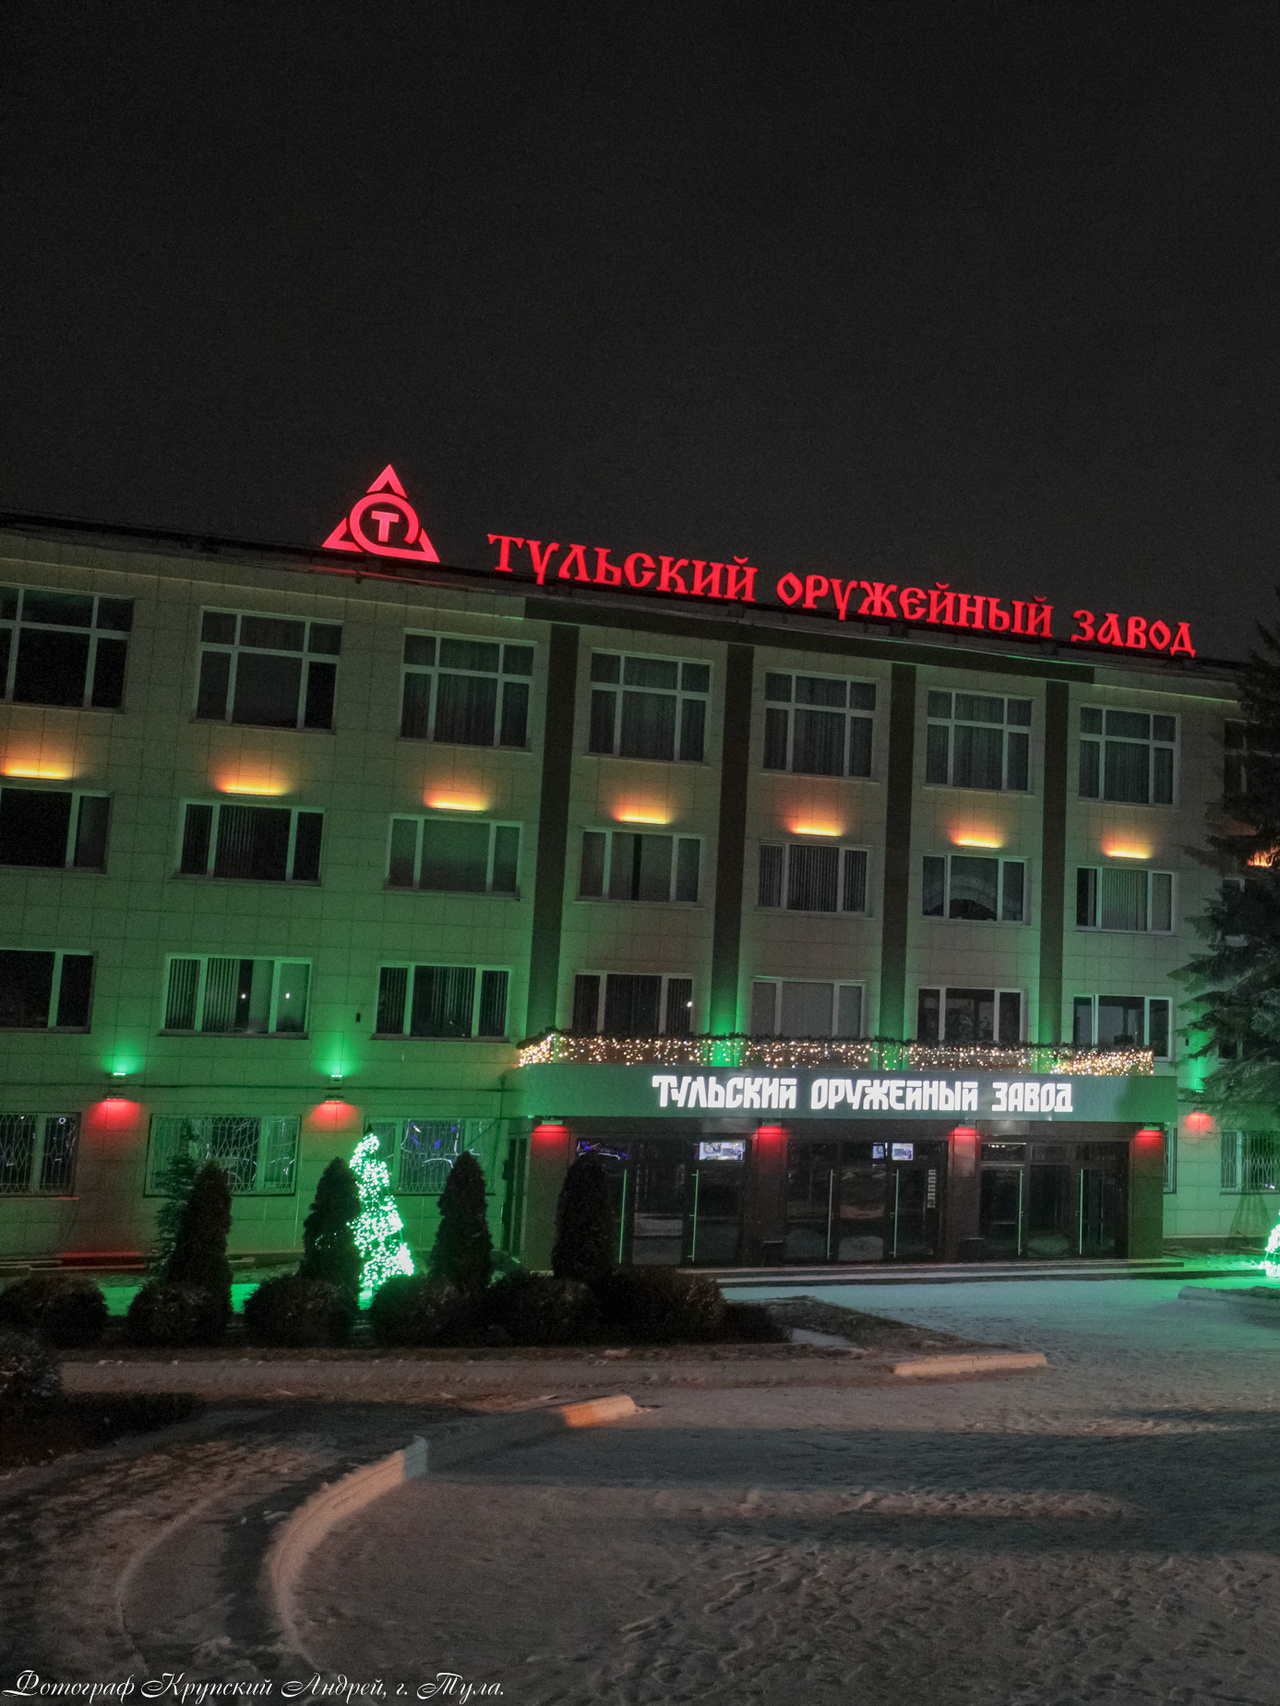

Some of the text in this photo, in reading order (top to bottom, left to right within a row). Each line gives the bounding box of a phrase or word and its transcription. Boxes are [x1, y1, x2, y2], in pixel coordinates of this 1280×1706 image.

[487, 533, 1197, 658] ТУЛЬСКИЙ ОРУЖЕЙНЫЙ ЗАВОД
[652, 1075, 1074, 1113] ТУЛЬСКИЙ ОРУЖЕЙНЫЙ ЗАВОД
